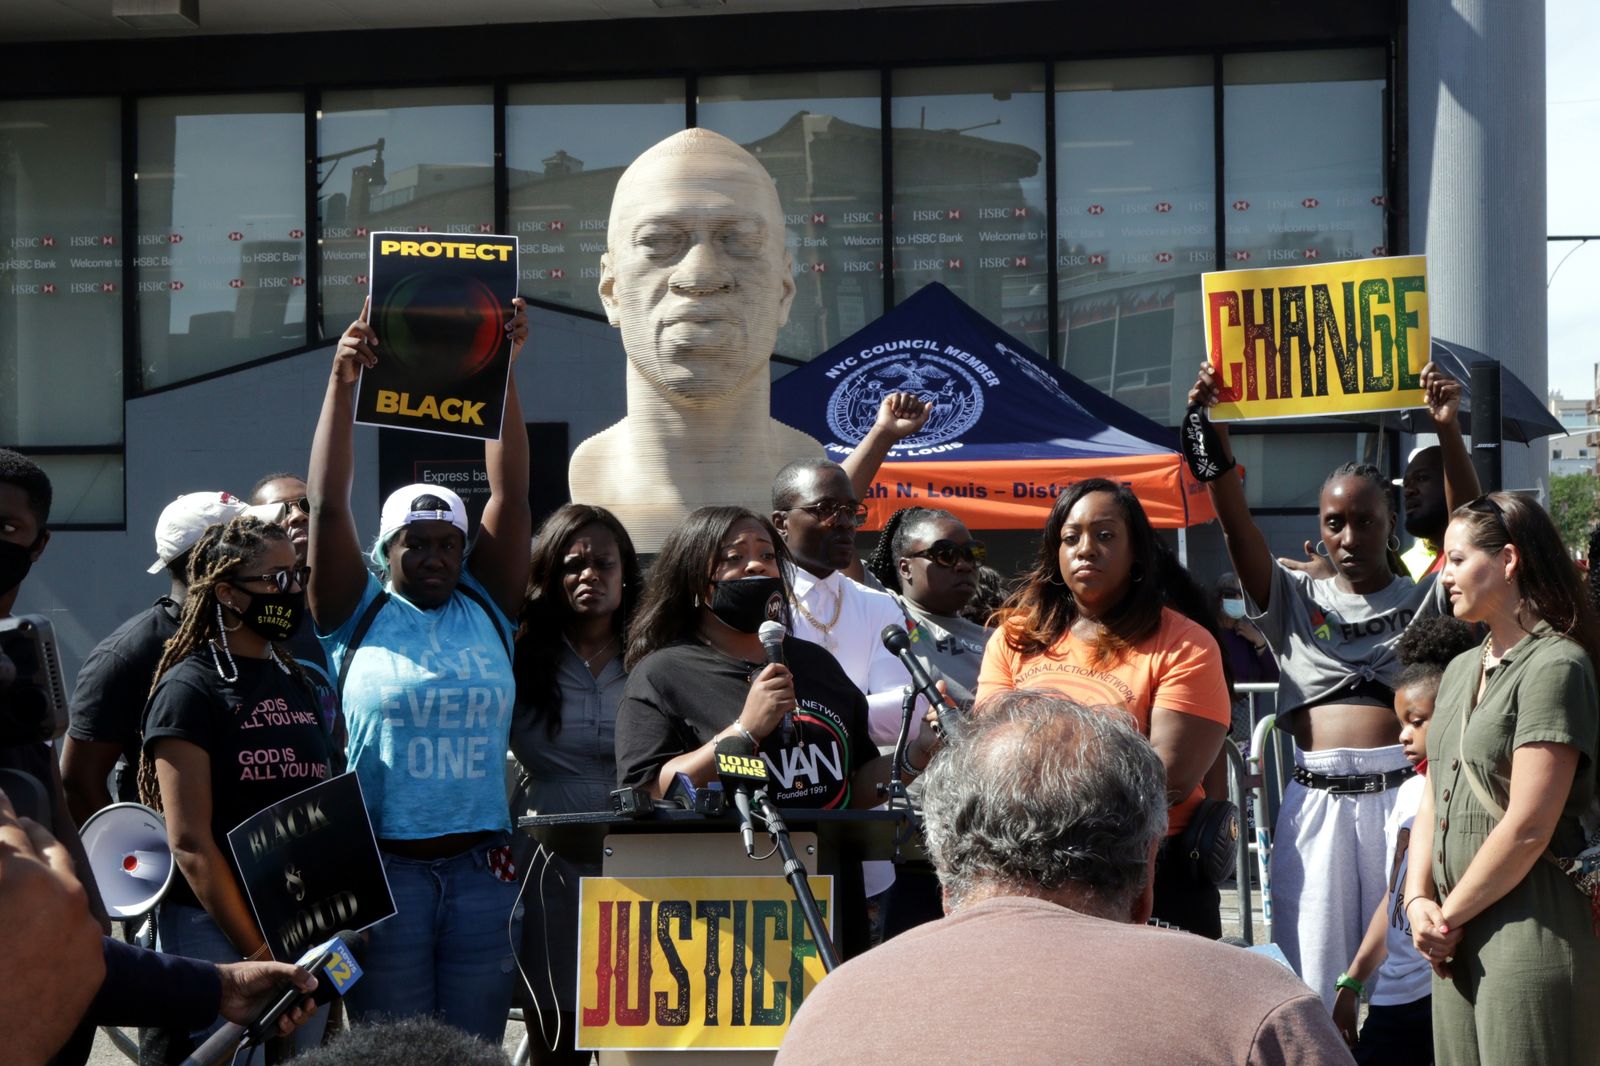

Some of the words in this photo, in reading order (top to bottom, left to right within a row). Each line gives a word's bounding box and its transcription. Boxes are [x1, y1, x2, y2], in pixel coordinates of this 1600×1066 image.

[843, 212, 874, 223] HSBC
[913, 210, 944, 221] HSBC
[979, 207, 1010, 219] HSBC
[323, 227, 351, 238] HSBC
[517, 221, 546, 231] HSBC
[11, 237, 39, 248] HSBC
[70, 236, 98, 246] HSBC
[138, 234, 165, 245] HSBC
[804, 236, 828, 247] Bank
[896, 236, 905, 244] to
[908, 233, 937, 244] HSBC
[939, 232, 963, 242] Bank
[979, 231, 1026, 242] Welcome
[1028, 231, 1038, 240] to
[323, 251, 366, 260] Welcome
[381, 240, 513, 262] PROTECT
[519, 244, 539, 254] SBC
[541, 243, 565, 253] Bank
[6, 259, 33, 269] HSBC
[34, 259, 56, 269] Bank
[71, 258, 113, 268] Welcome
[254, 253, 282, 263] HSBC
[914, 259, 944, 270] HSBC
[980, 257, 1010, 268] HSBC
[843, 261, 874, 272] HSBC
[139, 282, 166, 292] HSBC
[258, 277, 287, 288] HSBC
[323, 275, 352, 285] HSBC
[11, 284, 39, 295] HSBC
[70, 283, 98, 293] HSBC
[1208, 275, 1426, 404] CHANGE
[825, 356, 858, 379] NYC
[860, 339, 940, 359] COUNCIL
[944, 345, 1000, 388] MEMBER
[376, 389, 487, 426] BLACK
[907, 442, 964, 457] LOUIS
[424, 469, 469, 484] Express
[896, 482, 918, 499] N.
[927, 481, 988, 499] Louis
[265, 604, 283, 616] IT'S
[284, 608, 292, 619] A
[257, 615, 292, 631] STRATEGY
[1340, 608, 1414, 641] FLOYD
[1058, 663, 1099, 679] ACTION
[1099, 671, 1136, 704] NETWORK
[275, 698, 288, 712] IS
[381, 686, 512, 730] EVERY
[264, 712, 291, 726] YOU
[801, 699, 850, 738] NETWORK
[238, 748, 280, 765] GOD
[282, 747, 296, 762] IS
[407, 736, 487, 780] ONE
[718, 753, 765, 769] 1010
[240, 764, 277, 780] ALL
[279, 762, 309, 778] YOU
[719, 763, 767, 778] WINS
[757, 740, 844, 789] NAN
[776, 788, 809, 800] Founded
[810, 785, 829, 795] 1991
[247, 800, 331, 858] BLACK
[282, 863, 306, 901] &
[278, 890, 358, 956] PROUD
[337, 945, 358, 974] news
[582, 899, 827, 1027] JUSTICE
[325, 950, 352, 988] 12
